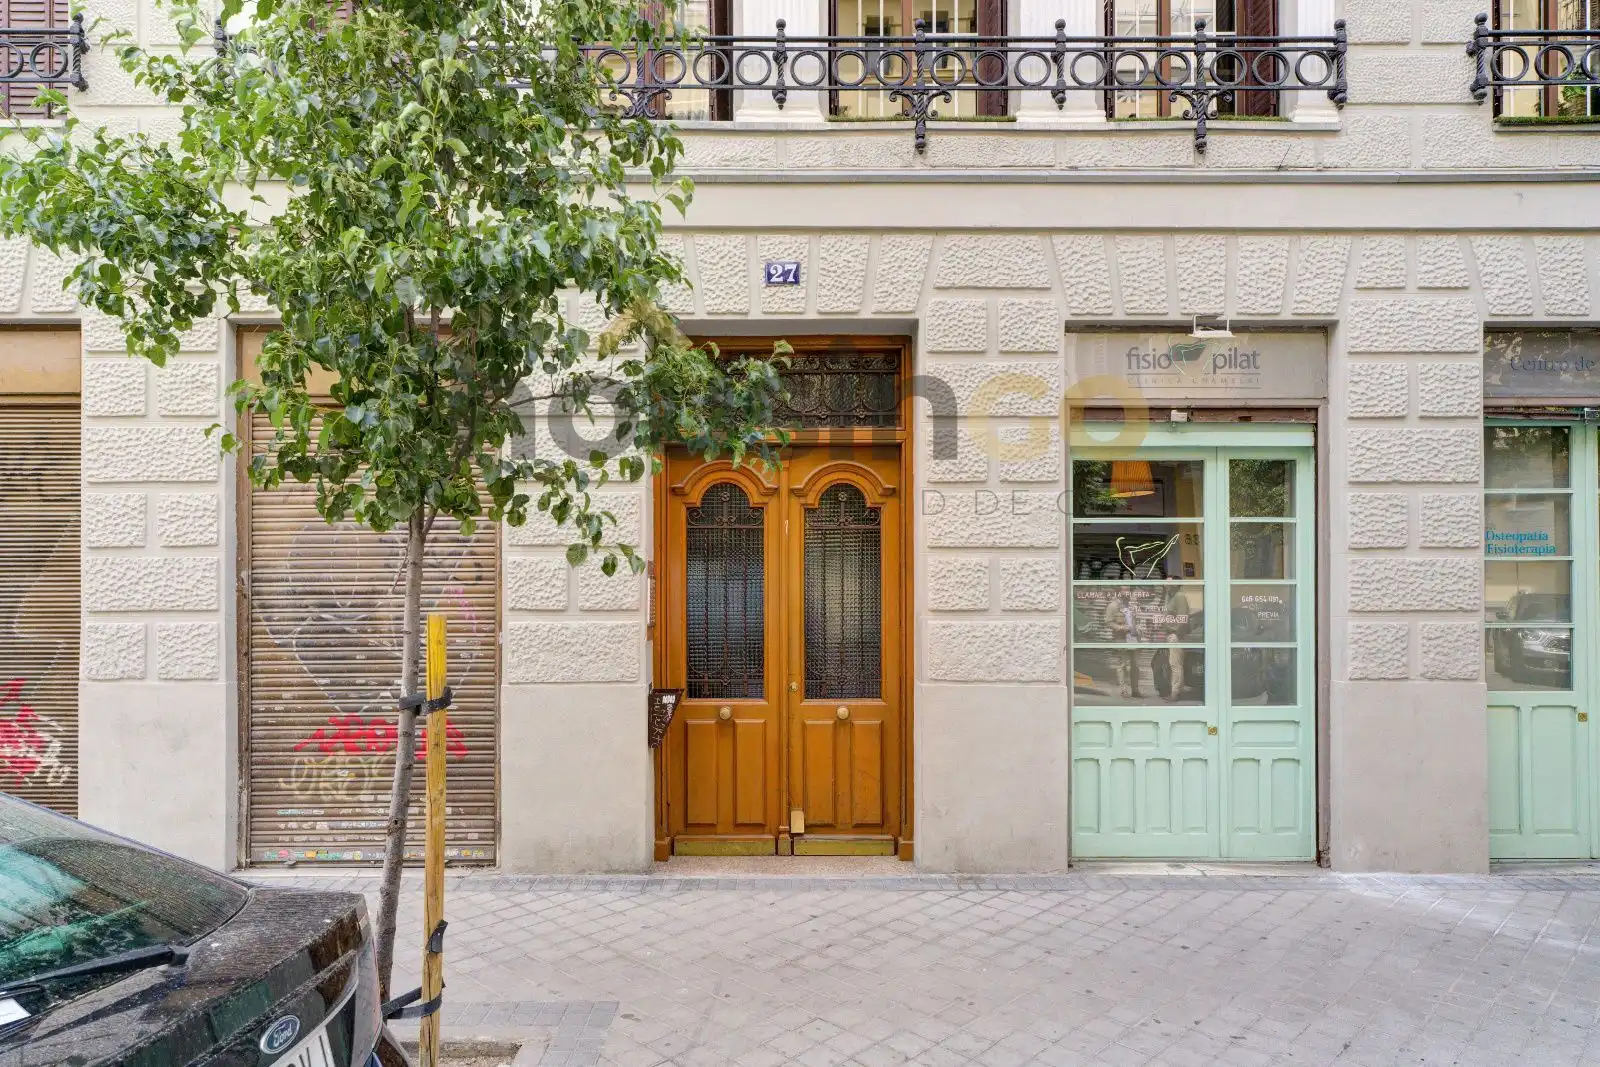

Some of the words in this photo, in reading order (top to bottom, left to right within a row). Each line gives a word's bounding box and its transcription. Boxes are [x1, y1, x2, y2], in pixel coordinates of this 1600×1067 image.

[769, 264, 797, 282] 27
[1126, 346, 1171, 370] fisio
[1213, 346, 1260, 375] pilat
[1487, 543, 1556, 556] Fisioterapia
[273, 1023, 293, 1047] Ford
